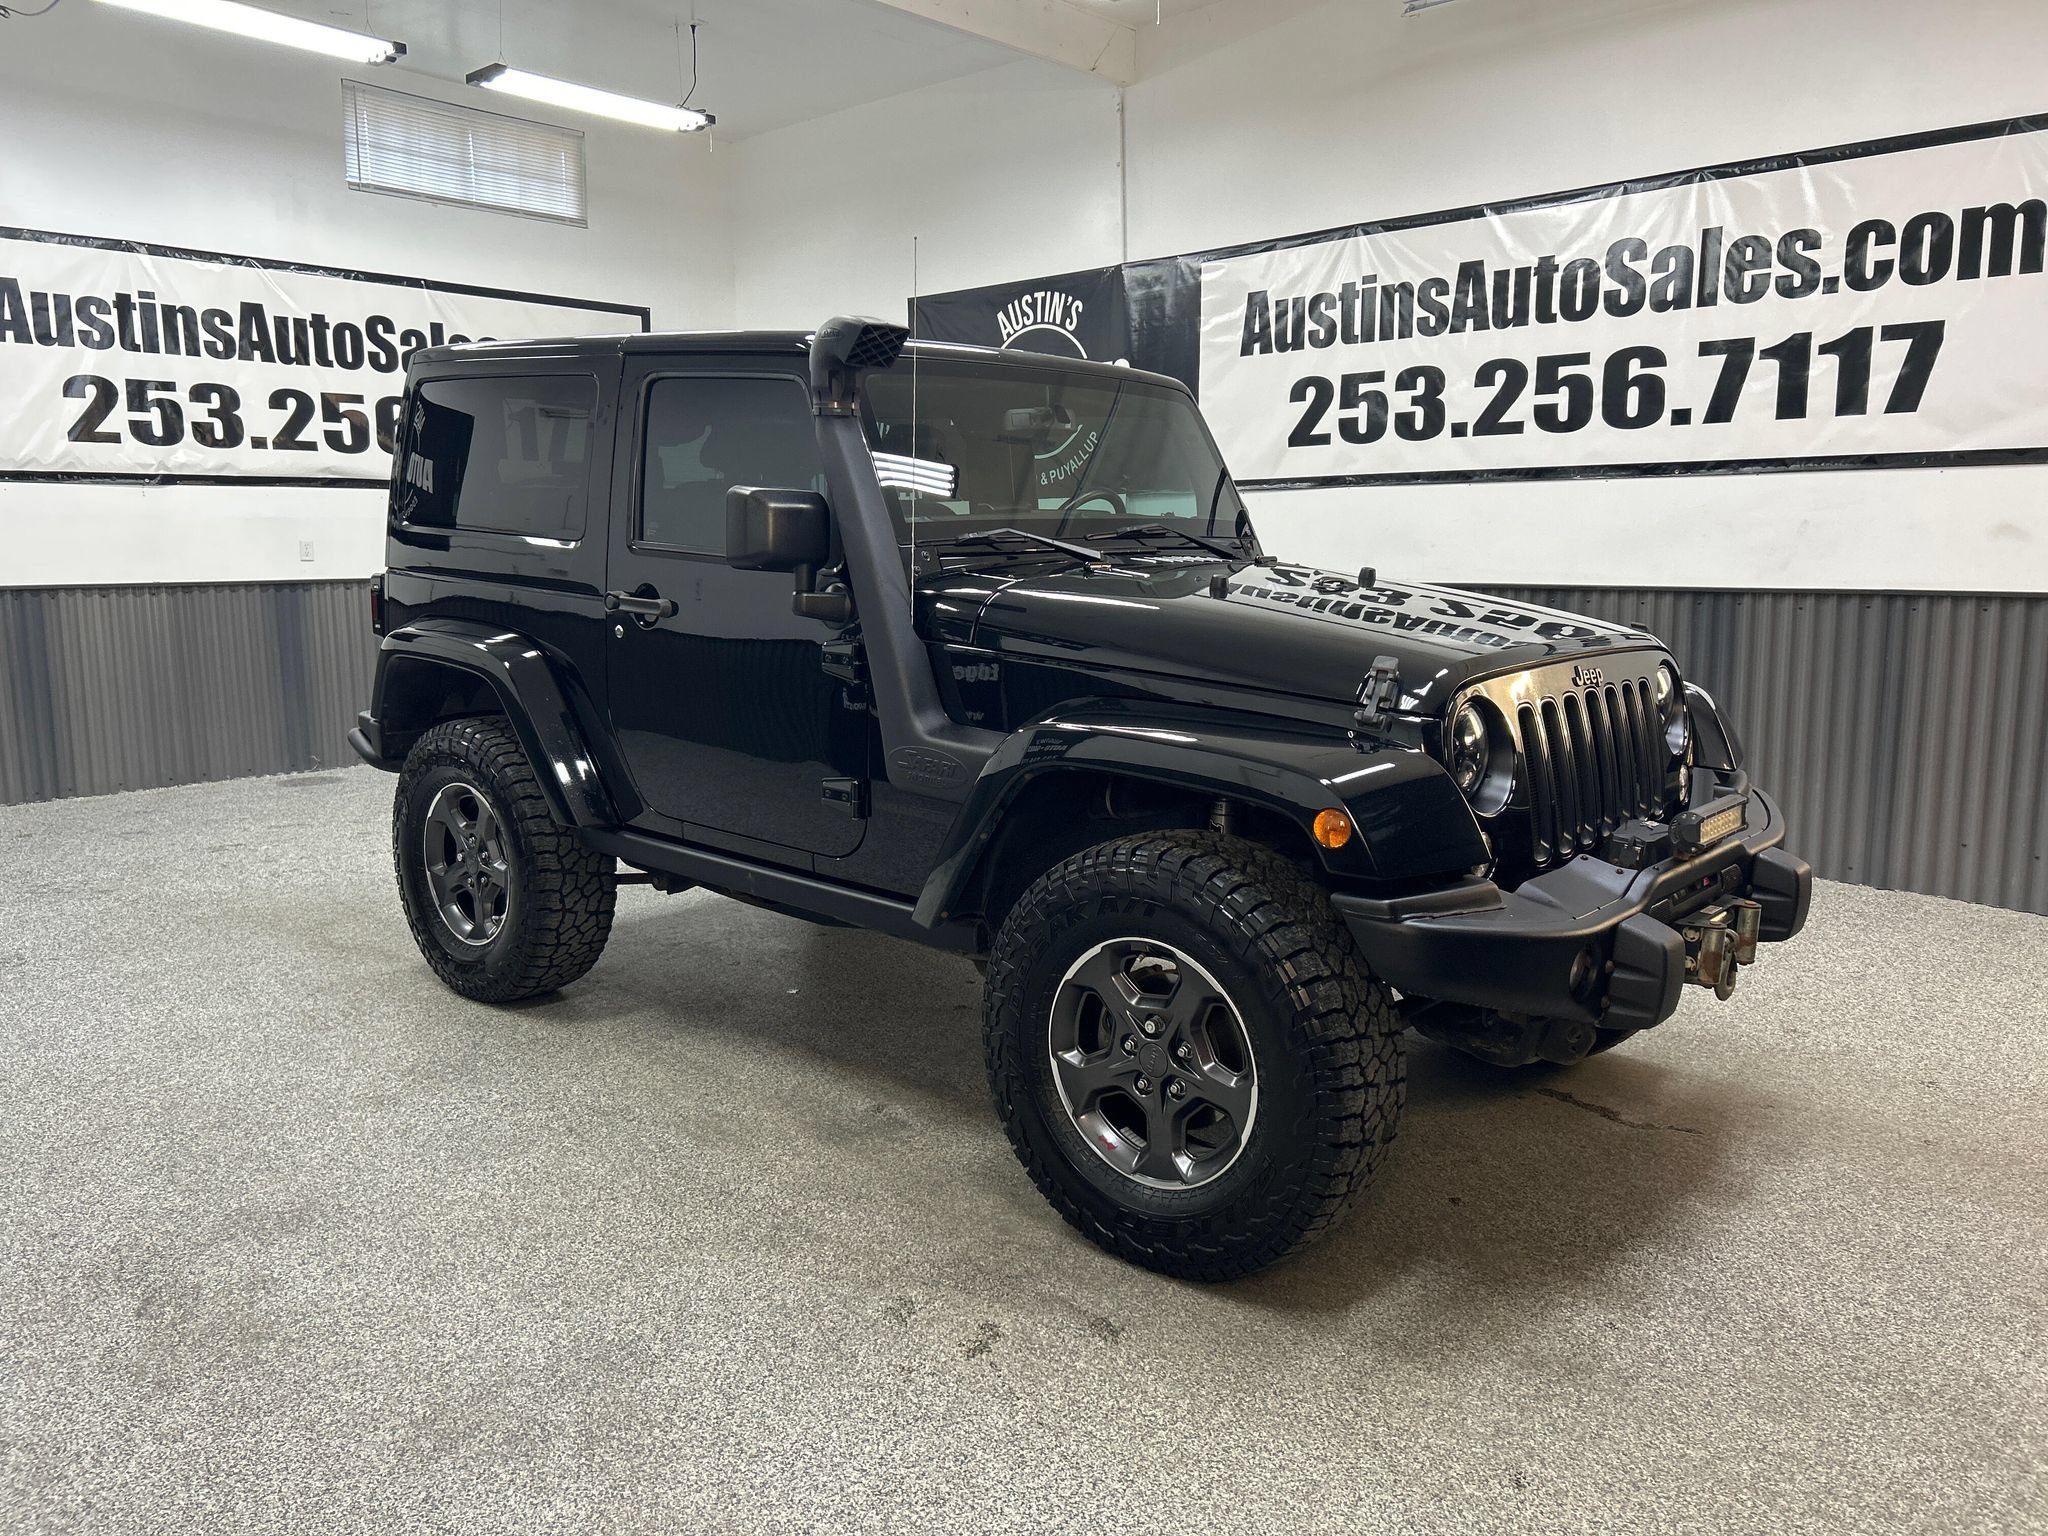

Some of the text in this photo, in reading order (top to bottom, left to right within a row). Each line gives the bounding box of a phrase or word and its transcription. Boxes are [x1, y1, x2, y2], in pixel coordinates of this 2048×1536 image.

[1240, 198, 2047, 357] AustinsAutoSales.com
[0, 276, 498, 374] AustinsAutoSa
[996, 291, 1083, 341] AUSTIN'S
[1288, 319, 1945, 448] 253.256.7117
[1049, 431, 1098, 484] PUYALLUP
[1572, 665, 1604, 687] Jeep
